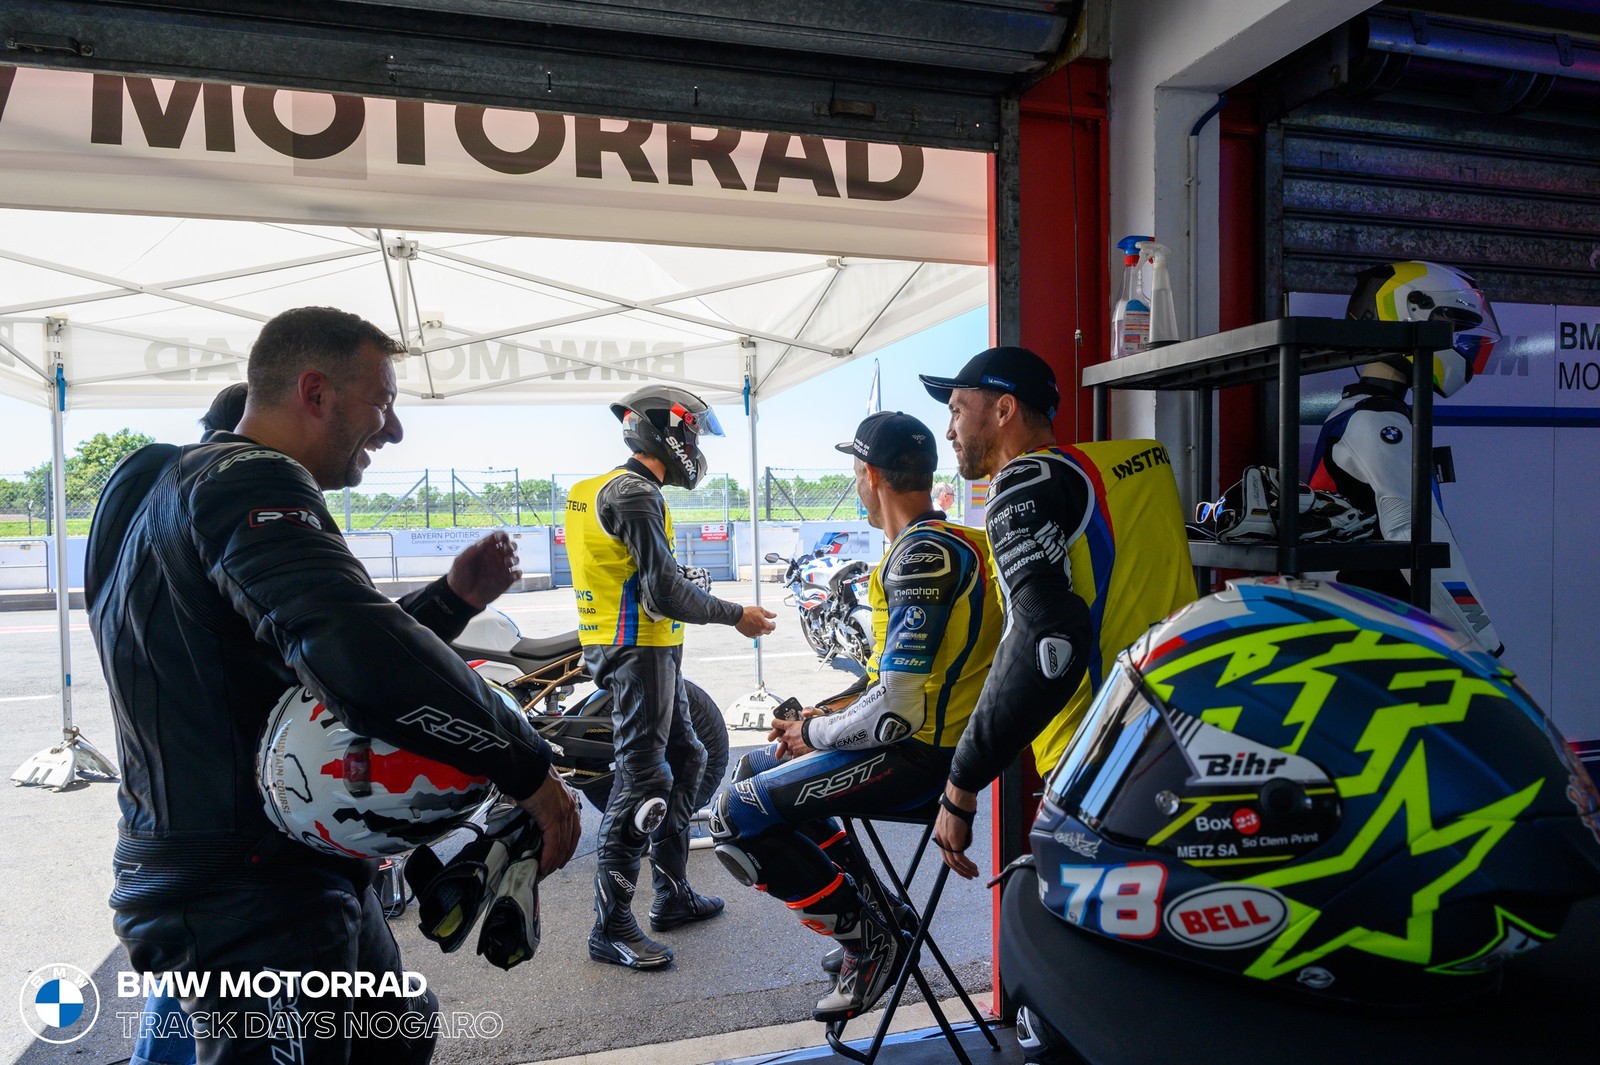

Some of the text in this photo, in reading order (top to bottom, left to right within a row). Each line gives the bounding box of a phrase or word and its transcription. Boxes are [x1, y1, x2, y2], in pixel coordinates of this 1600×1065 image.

[665, 436, 697, 476] SHARK
[566, 500, 588, 513] TEUR
[411, 531, 480, 540] BAYERN POITIERS
[397, 705, 510, 752] RST
[1198, 753, 1287, 776] Bihr
[794, 752, 887, 806] RST
[1195, 813, 1258, 832] Box 23
[1291, 832, 1319, 844] Print
[1177, 843, 1238, 858] METZ SA
[1060, 861, 1168, 939] 78
[1179, 900, 1270, 935] BELL
